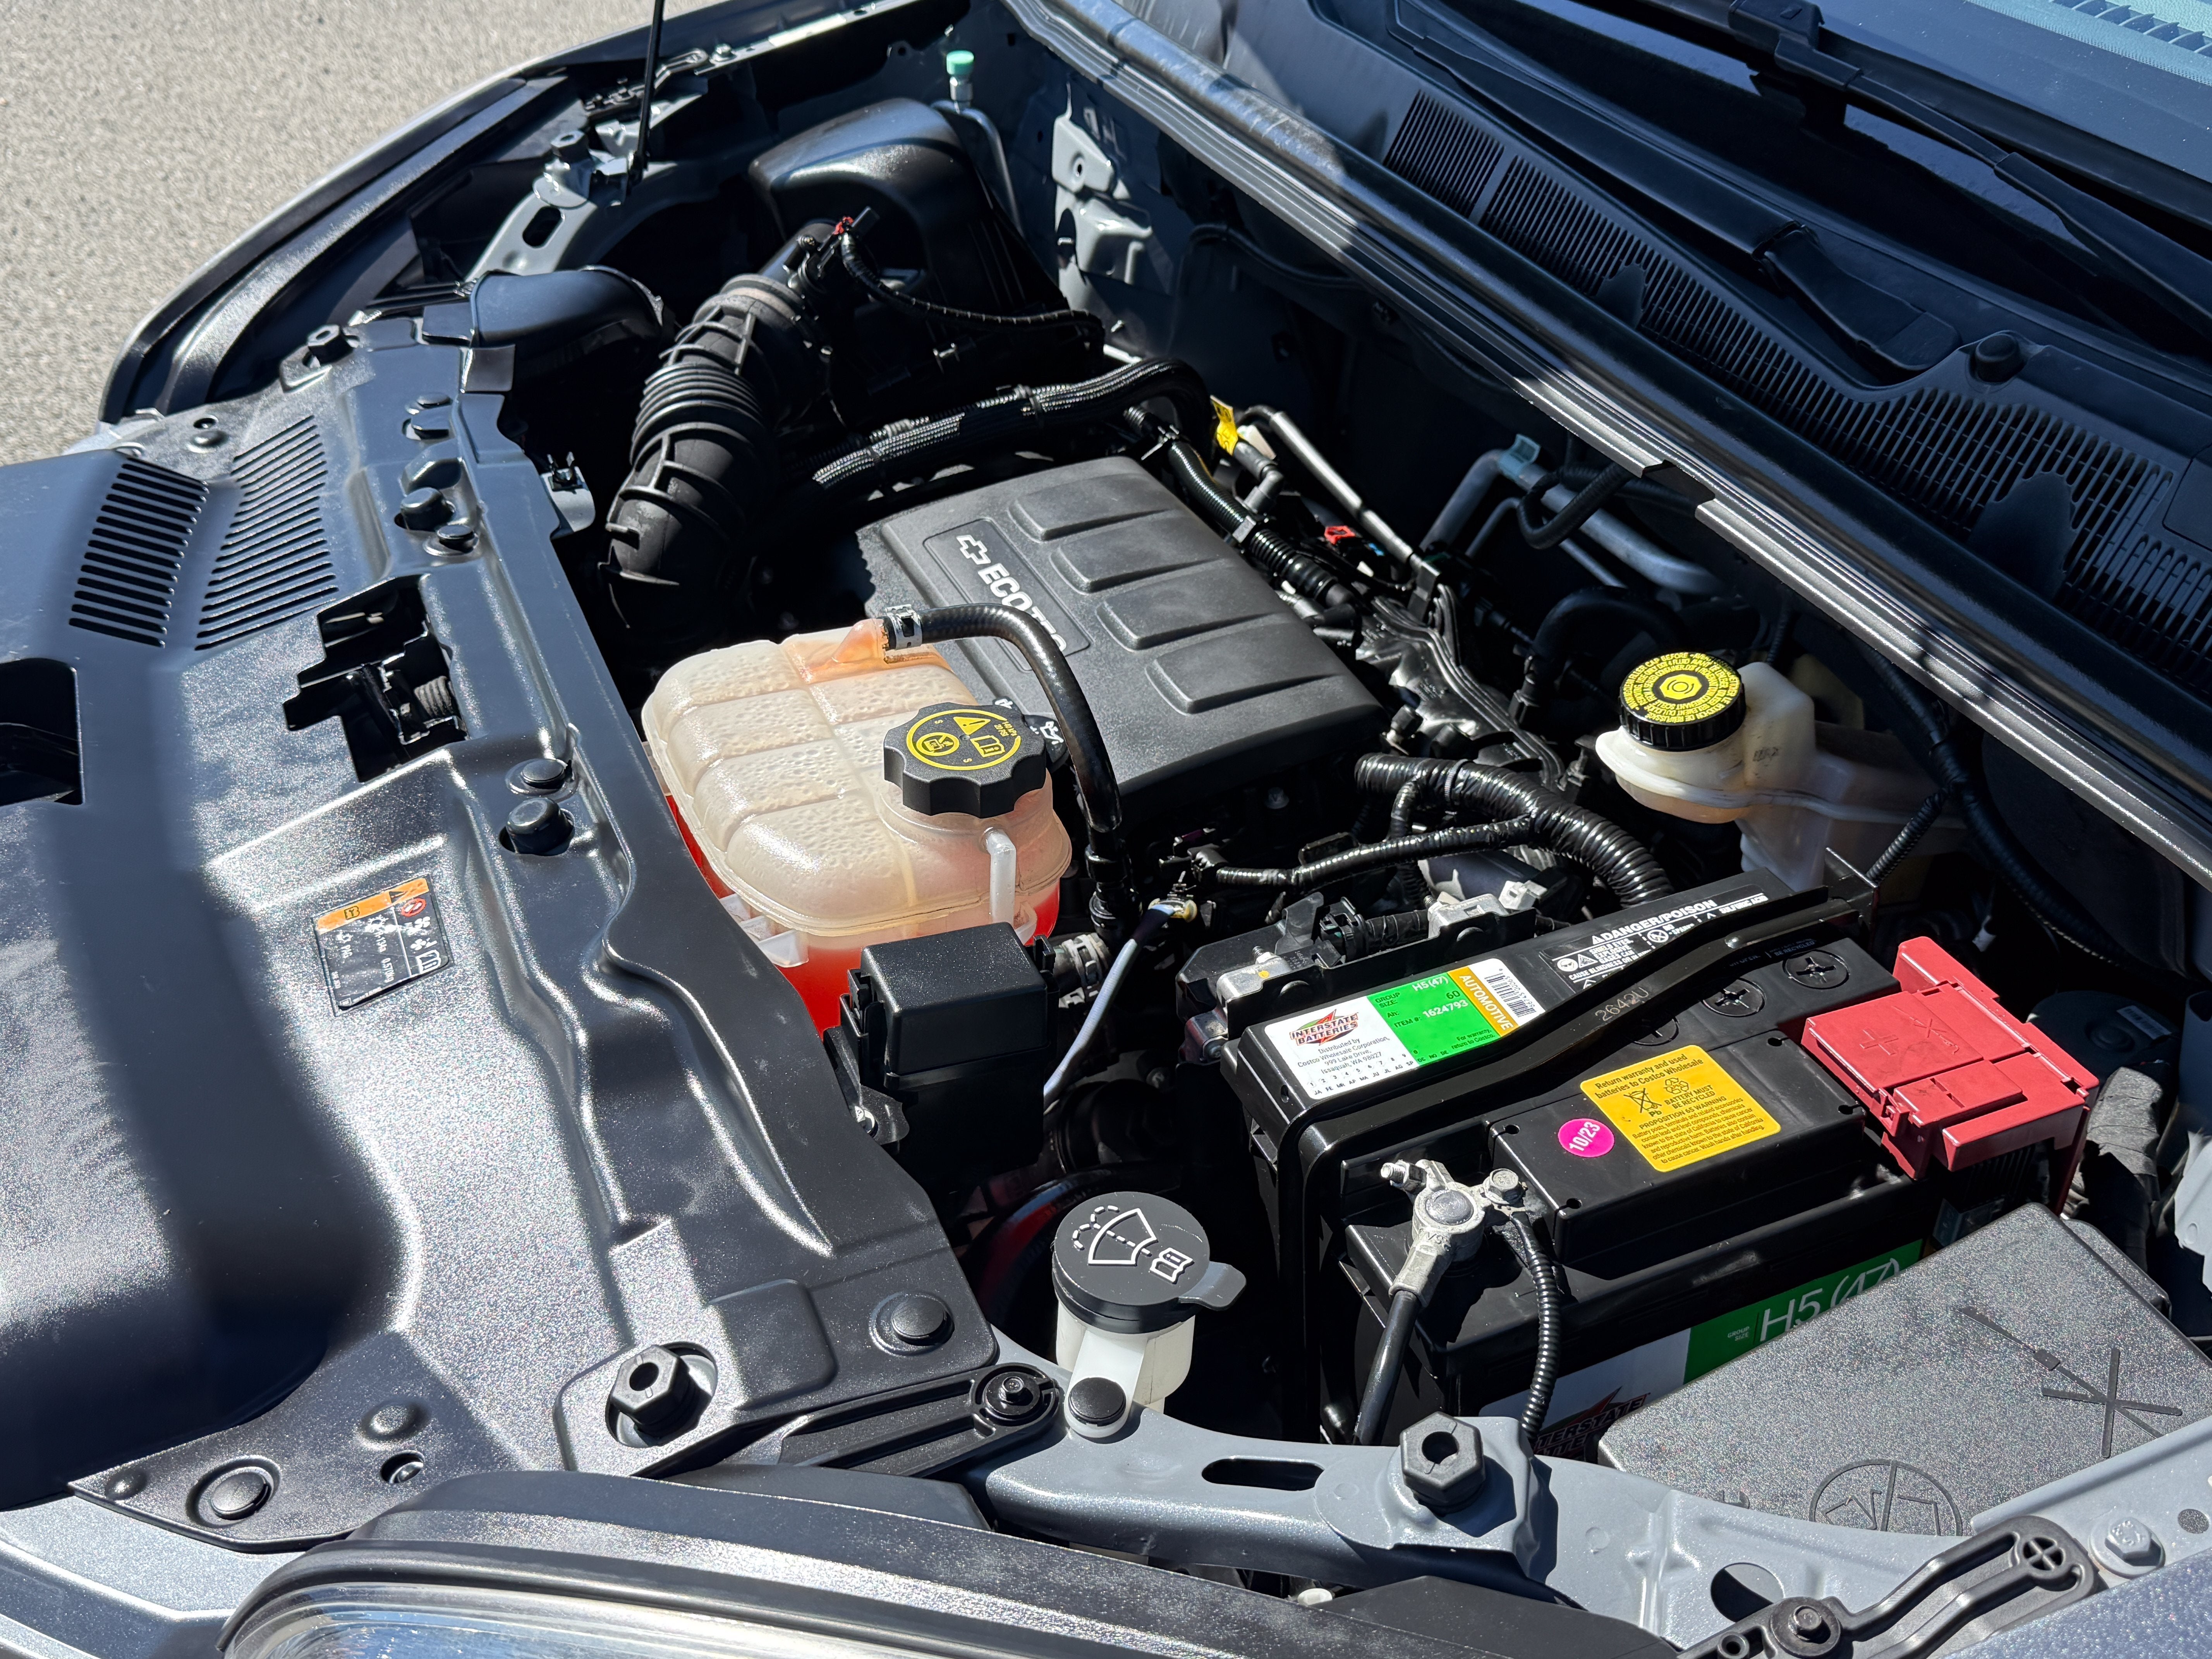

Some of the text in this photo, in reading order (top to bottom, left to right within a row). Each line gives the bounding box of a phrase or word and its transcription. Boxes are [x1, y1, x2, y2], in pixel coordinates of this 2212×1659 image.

[1644, 658, 1661, 667] CAP
[1660, 653, 1688, 661] BEFORE
[1636, 674, 1649, 683] USE
[1752, 895, 1769, 905] ACID
[1600, 900, 1717, 941] DANGER/POISON
[341, 945, 352, 958] PAG
[1589, 943, 1613, 955] SHIELD
[1593, 945, 1631, 959] EXPLOSIVE
[1598, 953, 1621, 964] GASES
[1621, 950, 1635, 958] CAN
[1784, 941, 1815, 954] RECYCLED
[1569, 970, 1590, 981] CAUSE
[1589, 960, 1623, 974] BLINDNESS
[1412, 975, 1448, 991] H5(47)
[1375, 992, 1400, 1003] GROUP
[1446, 990, 1460, 1000] 60
[1459, 975, 1514, 1030] AUTOMOTIVE
[1595, 987, 1649, 1022] 2642U
[1394, 1018, 1413, 1028] ITEM
[1422, 999, 1468, 1018] 1624793
[1291, 1013, 1358, 1039] INTERSTATE
[1298, 1021, 1357, 1045] BATTERIES
[1298, 1036, 1390, 1067] Costco Wholesale Corporation,
[1318, 1039, 1352, 1054] Distributed
[1451, 1041, 1467, 1049] return
[1474, 1034, 1496, 1042] Costco.
[1321, 1062, 1352, 1074] Issaquah,
[1362, 1051, 1382, 1061] 98027
[1595, 1054, 1688, 1089] Return warranty and used
[1595, 1085, 1630, 1099] batteries
[1638, 1072, 1665, 1084] Costco
[1664, 1058, 1704, 1075] Wholesale
[1664, 1084, 1713, 1105] BATTERY MUST
[1681, 1091, 1716, 1106] RECYCLED
[1632, 1130, 1652, 1139] Battery
[1665, 1117, 1688, 1127] terminals
[1698, 1107, 1715, 1116] related
[1714, 1097, 1743, 1110] accessories
[1639, 1110, 1686, 1129] PROPOSITION
[1694, 1096, 1727, 1110] WARNING
[1641, 1133, 1661, 1142] contain
[1720, 1104, 1745, 1115] chemicals
[1569, 1121, 1600, 1151] 10/23
[1642, 1140, 1661, 1149] known
[1692, 1120, 1716, 1131] California
[1721, 1113, 1737, 1121] cause
[1736, 1108, 1753, 1116] cancer
[1652, 1152, 1666, 1160] other
[1666, 1143, 1692, 1155] chemicals
[1690, 1137, 1708, 1146] known
[1739, 1117, 1764, 1128] California
[1660, 1137, 1691, 1150] reproductive
[1704, 1123, 1727, 1134] Batteries
[1737, 1113, 1756, 1122] contain
[1668, 1153, 1683, 1161] cause
[1683, 1147, 1701, 1156] cancer.
[1699, 1141, 1716, 1149] Wash
[1714, 1136, 1731, 1144] hands
[1727, 1326, 1750, 1338] GROUP
[1735, 1332, 1749, 1341] SIZE
[1537, 1396, 1644, 1448] TERSTATE
